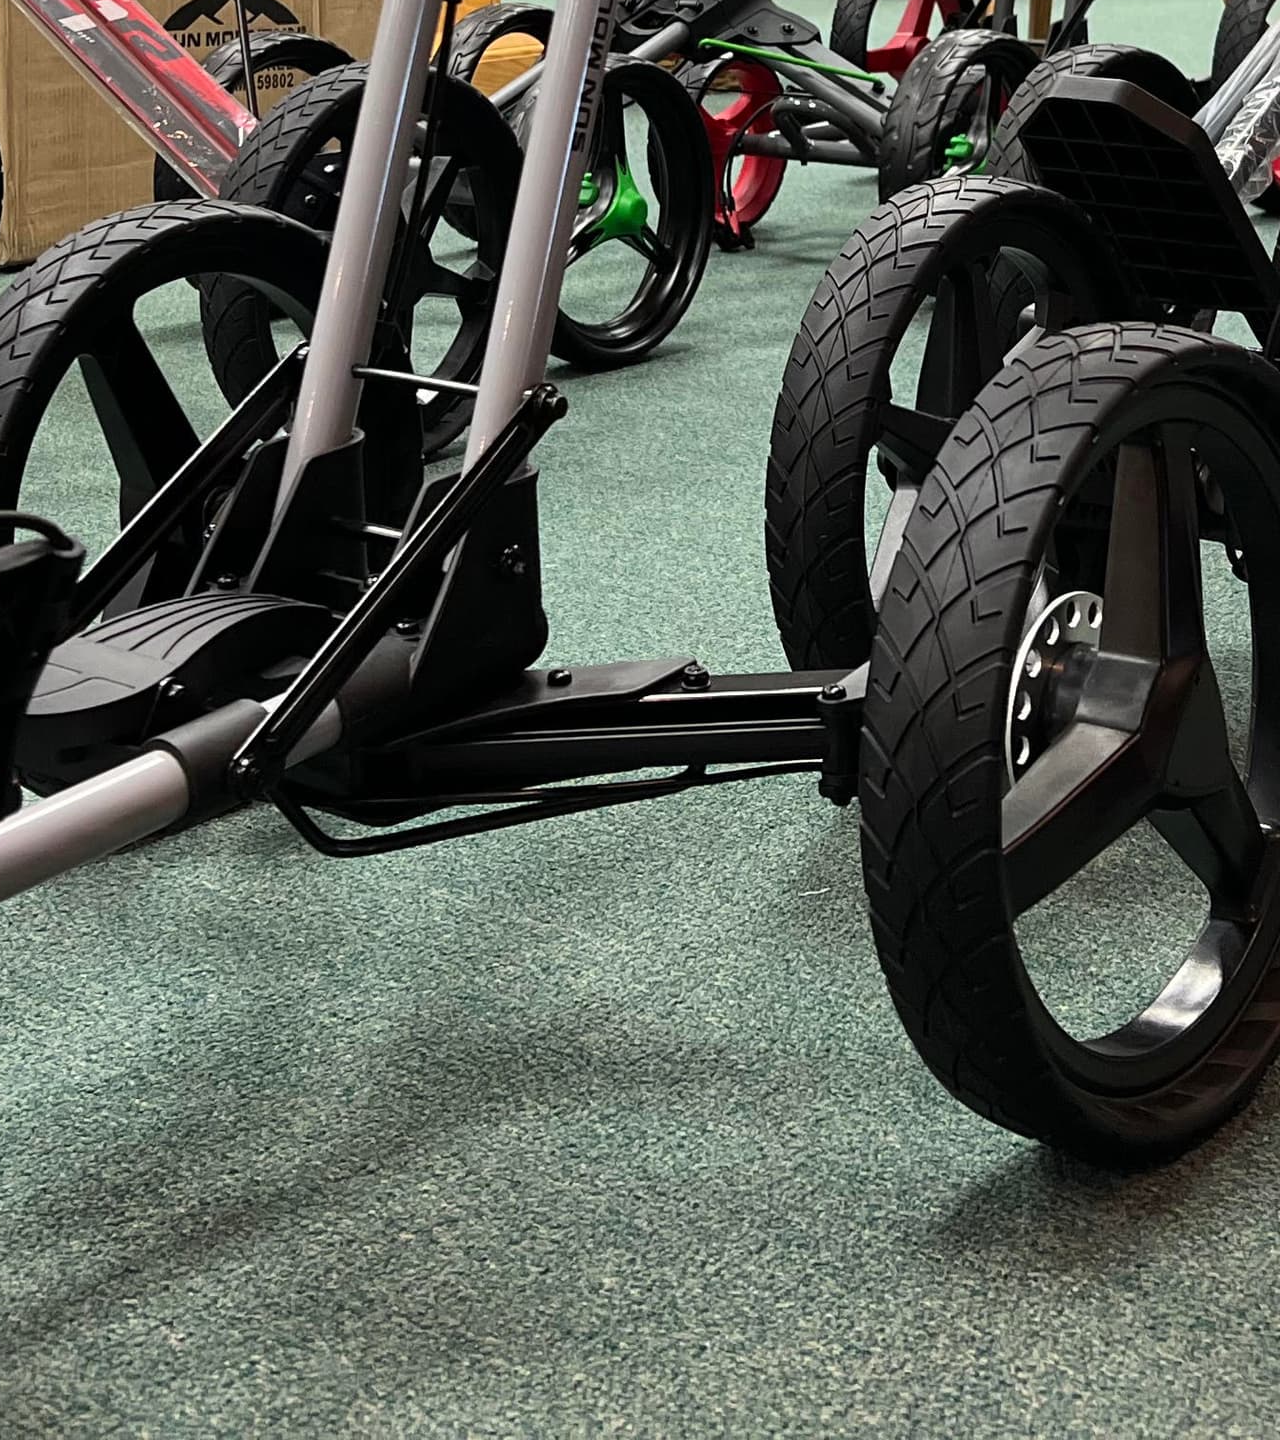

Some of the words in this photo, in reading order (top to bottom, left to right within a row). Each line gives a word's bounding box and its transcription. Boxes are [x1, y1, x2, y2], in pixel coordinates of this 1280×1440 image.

[173, 31, 201, 48] UN
[257, 72, 294, 91] 59802
[571, 80, 599, 154] SUN
